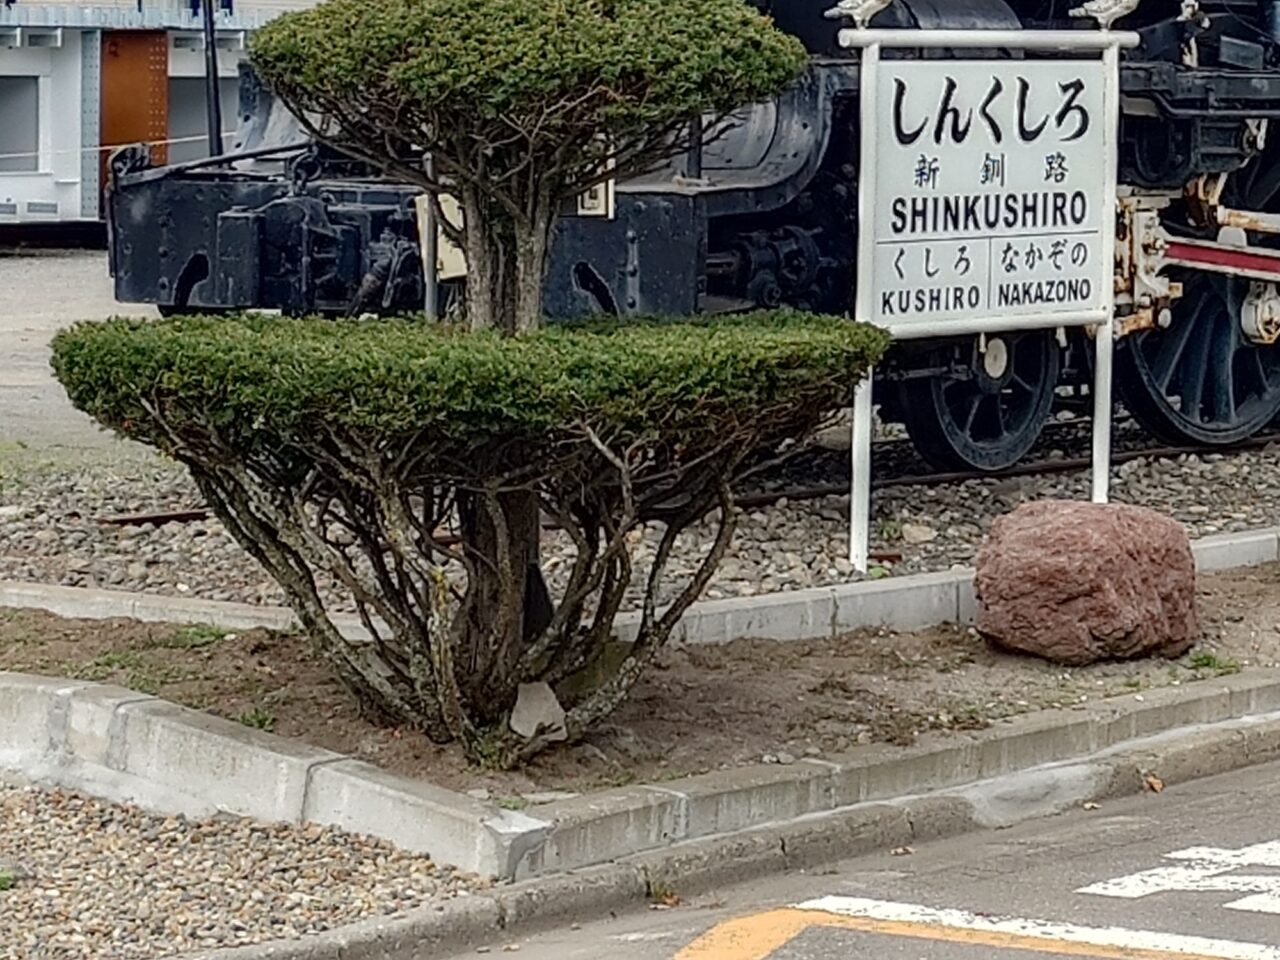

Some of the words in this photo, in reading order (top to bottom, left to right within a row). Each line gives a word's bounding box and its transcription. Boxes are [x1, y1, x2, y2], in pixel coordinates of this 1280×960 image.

[892, 76, 1091, 145] しんくしろ
[914, 151, 1069, 190] 新釧路
[891, 191, 1087, 233] SHINKUSHIRO
[894, 245, 971, 280] くしろ
[1002, 239, 1088, 273] なかぞの
[881, 285, 981, 315] KUSHIRO
[998, 279, 1091, 308] NAKAZONO
